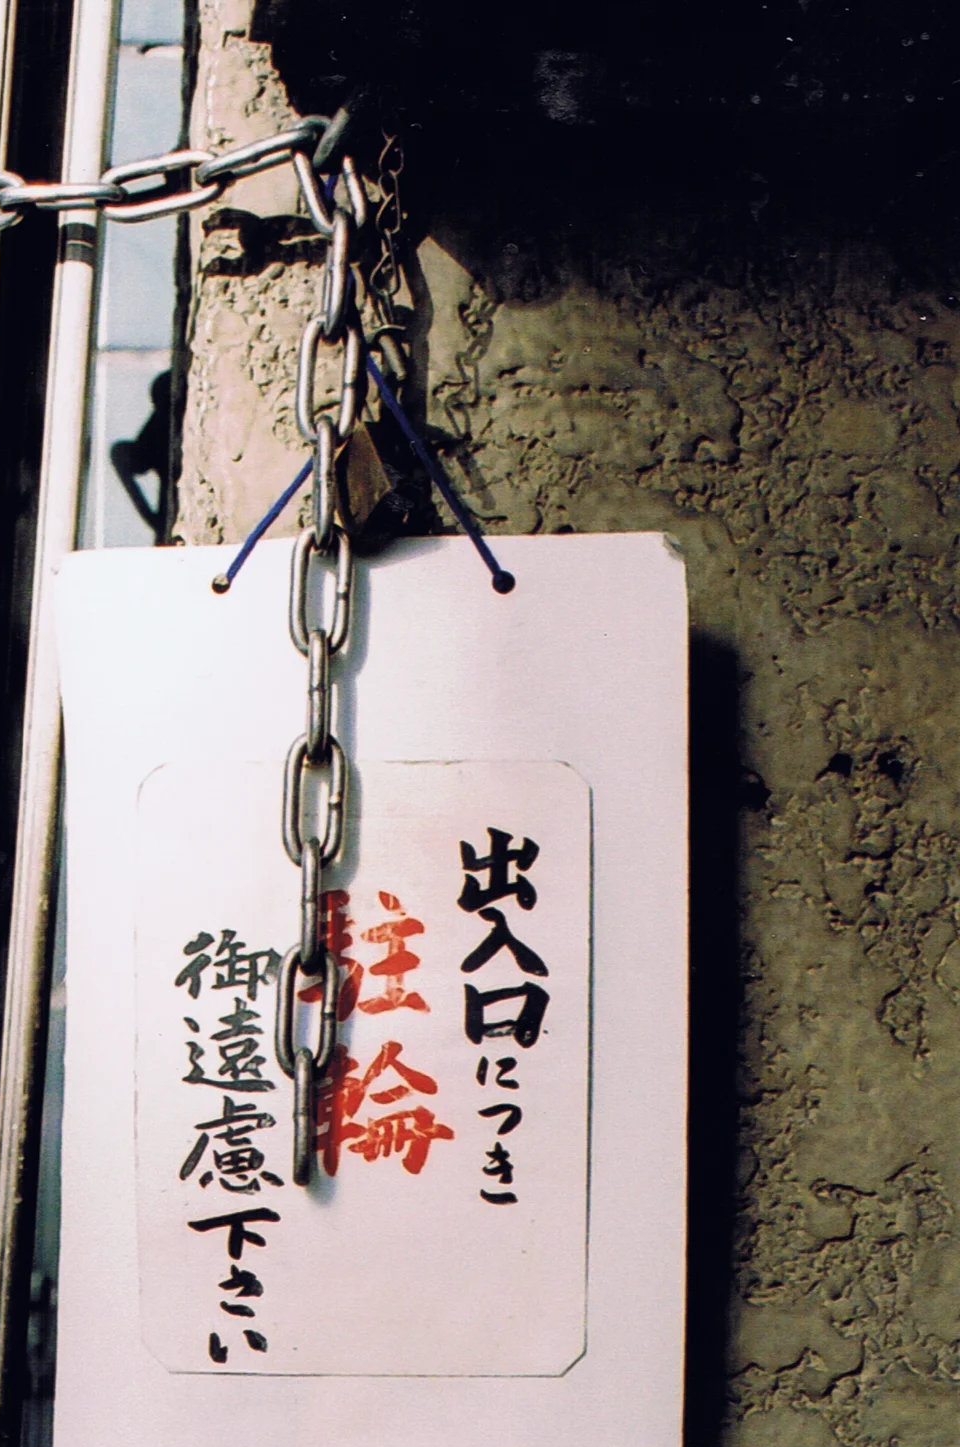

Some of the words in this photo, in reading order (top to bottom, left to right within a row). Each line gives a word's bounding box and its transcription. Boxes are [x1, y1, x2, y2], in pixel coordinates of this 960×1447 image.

[174, 929, 285, 1363] 御遠慮下さい
[297, 889, 455, 1178] 駐輪
[456, 827, 551, 1205] 出入口につき
